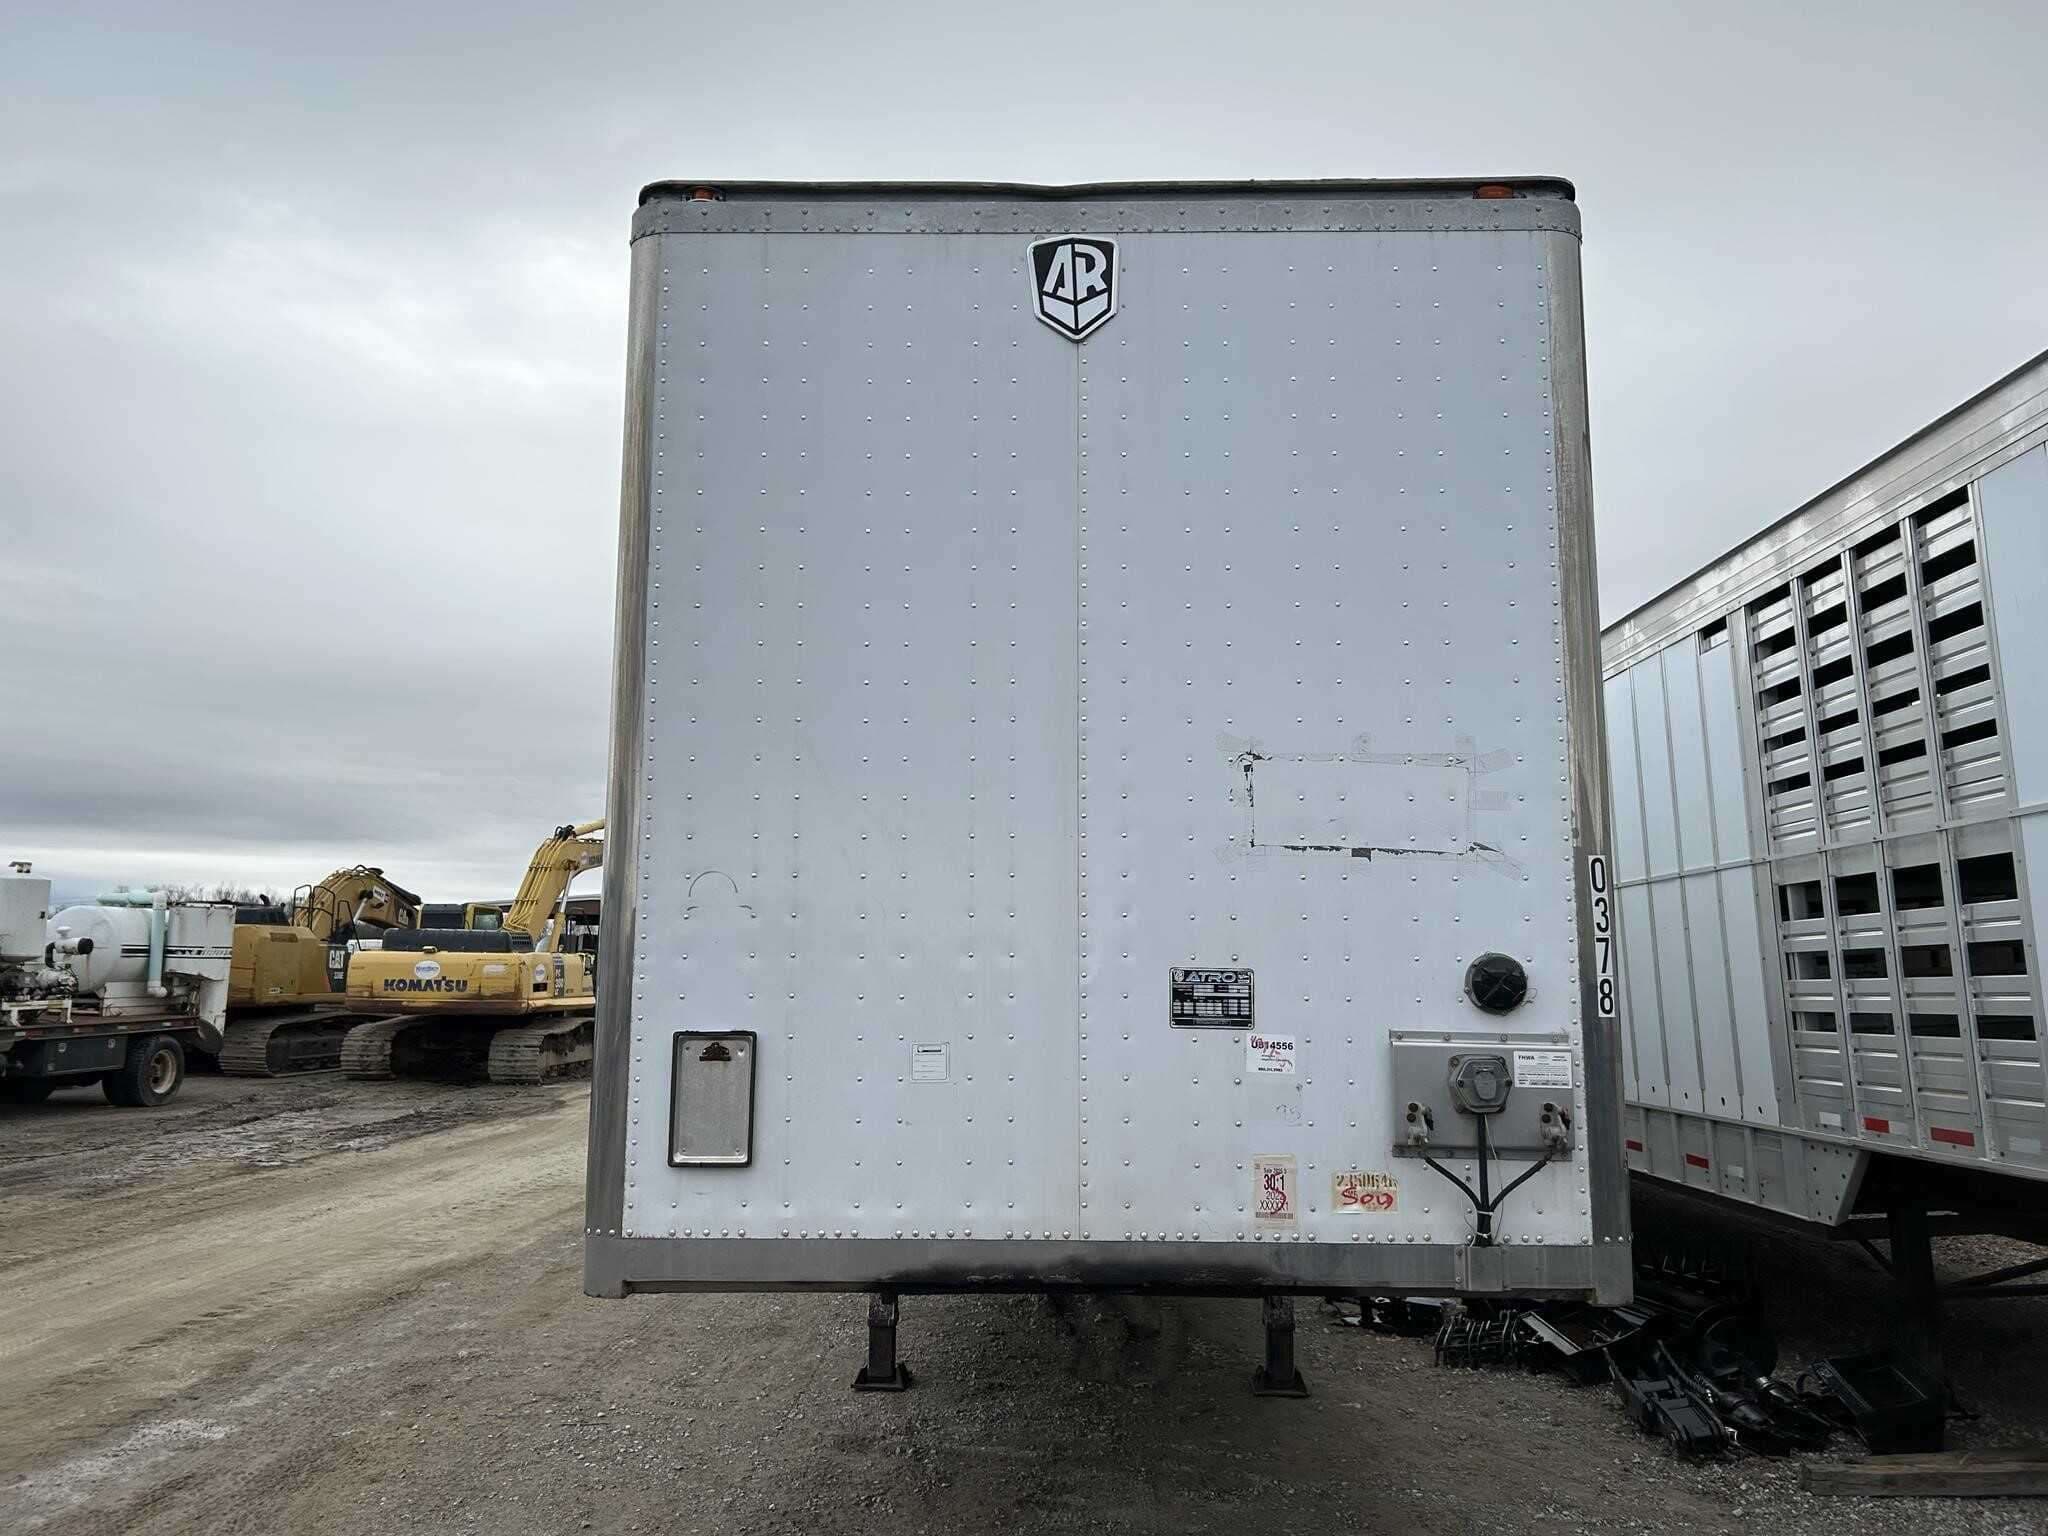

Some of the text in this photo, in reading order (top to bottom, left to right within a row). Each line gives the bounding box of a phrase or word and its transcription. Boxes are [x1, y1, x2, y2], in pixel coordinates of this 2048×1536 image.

[1590, 857, 1614, 1015] 0378
[329, 950, 346, 969] CAT
[383, 976, 468, 992] KOMATSU
